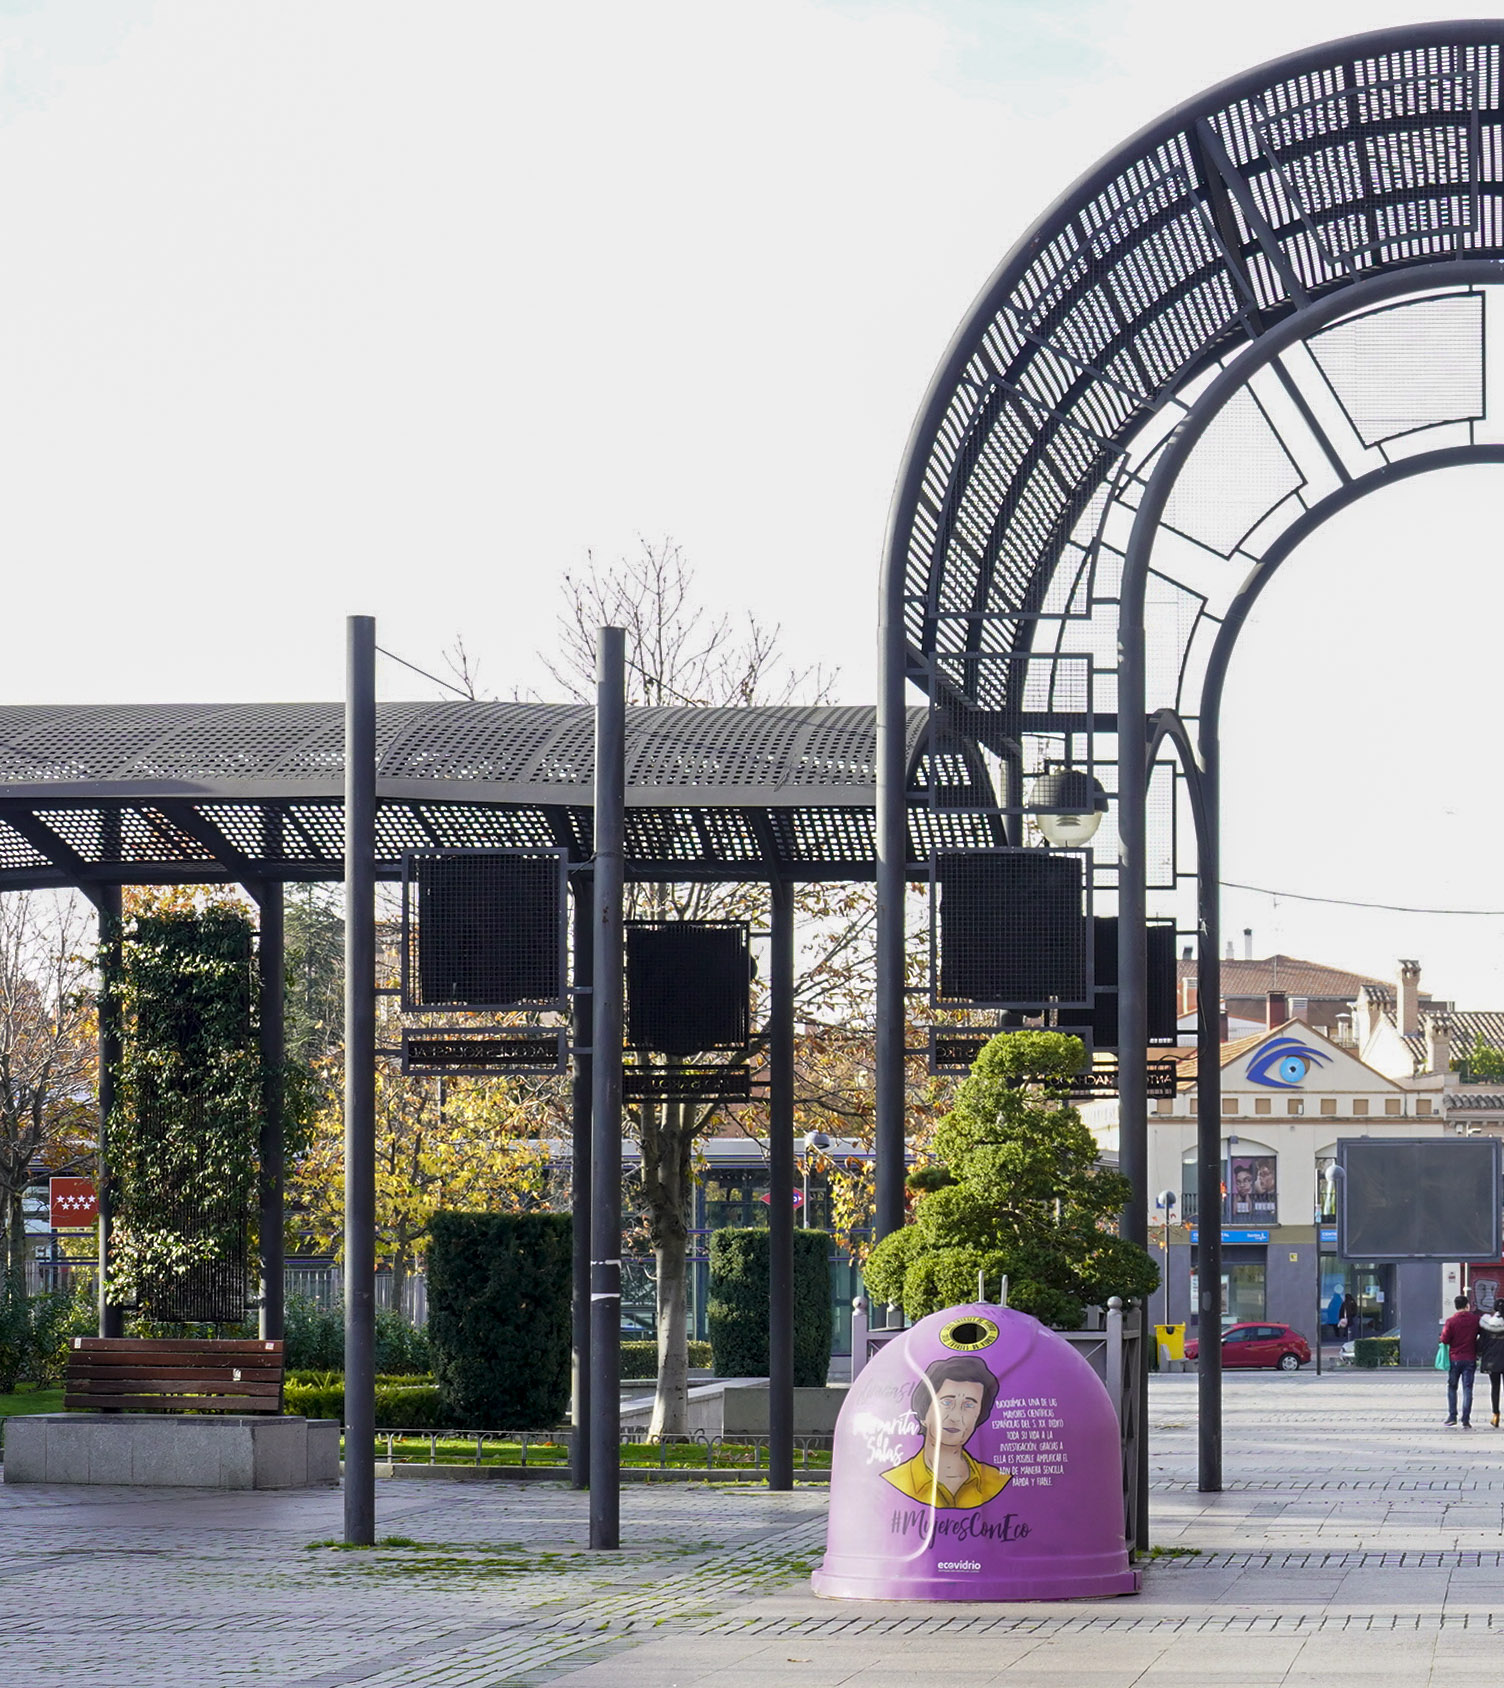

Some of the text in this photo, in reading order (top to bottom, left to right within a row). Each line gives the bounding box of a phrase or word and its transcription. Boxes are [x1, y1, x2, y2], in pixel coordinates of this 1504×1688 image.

[1028, 1398, 1040, 1407] UNA
[1041, 1398, 1048, 1407] DE
[1048, 1398, 1058, 1407] LAS
[1002, 1409, 1026, 1418] MAYORES
[991, 1418, 1020, 1429] ESPAÑOLAS
[1021, 1419, 1031, 1429] DEL
[1006, 1431, 1019, 1440] TODA
[1021, 1431, 1028, 1440] SU
[1029, 1431, 1040, 1440] VIDA
[1046, 1431, 1053, 1440] LA
[1039, 1441, 1058, 1451] GRACIAS
[993, 1453, 1068, 1463] ELLA ES POSIBLE AMPLIFICAR EL
[999, 1466, 1011, 1475] ADN
[1012, 1466, 1018, 1475] DE
[1020, 1465, 1042, 1475] MANERA
[891, 1509, 1033, 1549] #MujeresConEco
[937, 1559, 982, 1570] ecovidrio
